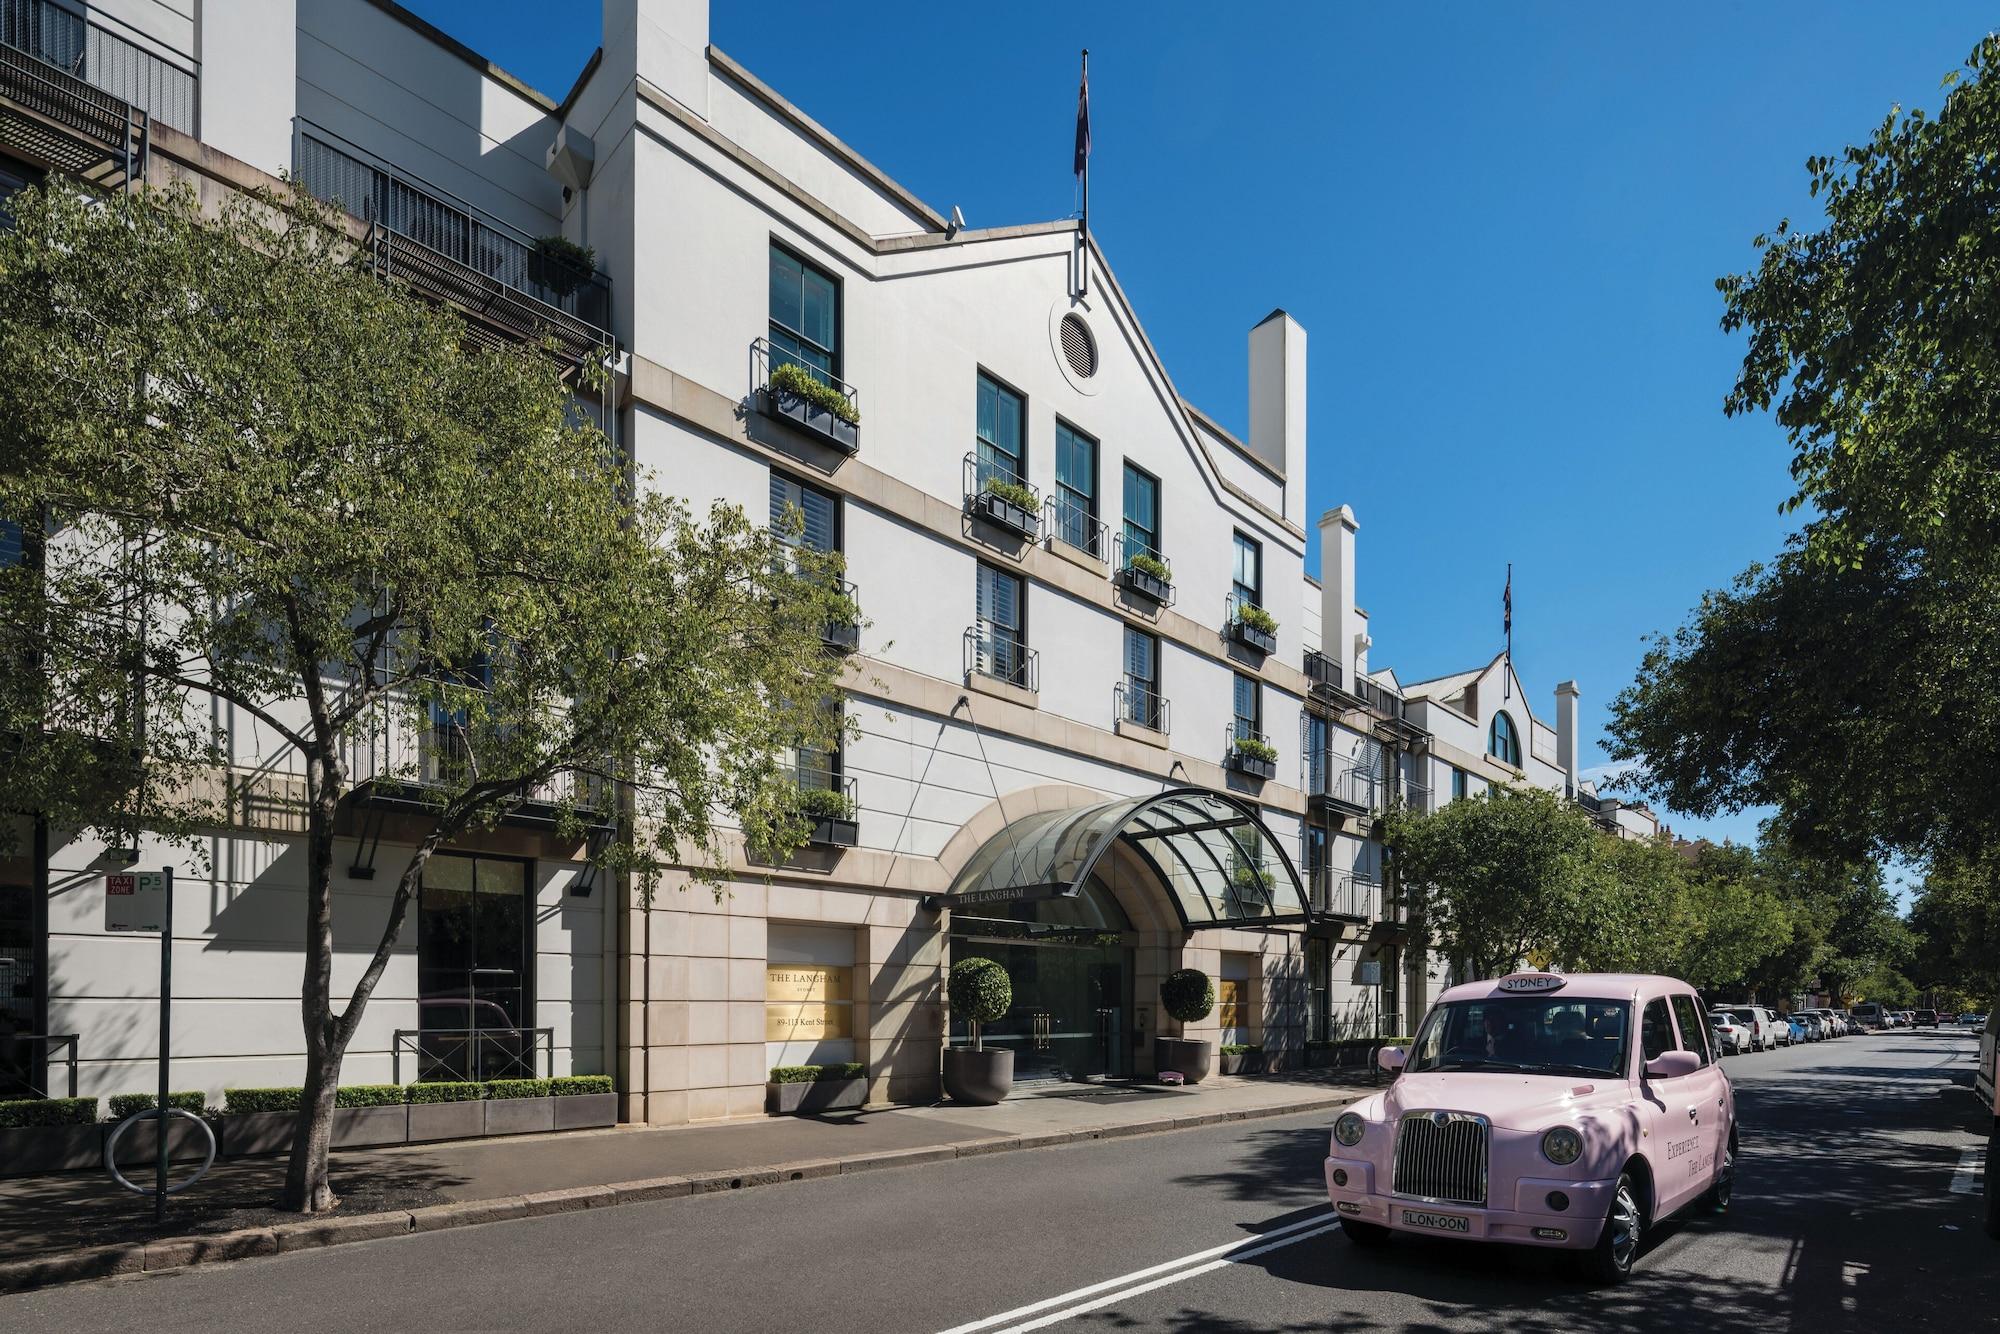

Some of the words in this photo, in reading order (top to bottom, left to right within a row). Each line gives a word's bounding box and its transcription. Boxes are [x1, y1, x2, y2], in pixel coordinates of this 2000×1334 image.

[109, 877, 133, 886] TAXI
[111, 885, 131, 894] ZONE
[959, 894, 977, 904] THE
[978, 888, 1025, 902] LANGHAM
[769, 973, 791, 983] THE
[793, 974, 841, 984] LANGHAM
[1507, 977, 1552, 989] SYDNEY
[777, 1018, 799, 1027] 89-113
[800, 1018, 815, 1026] Kent
